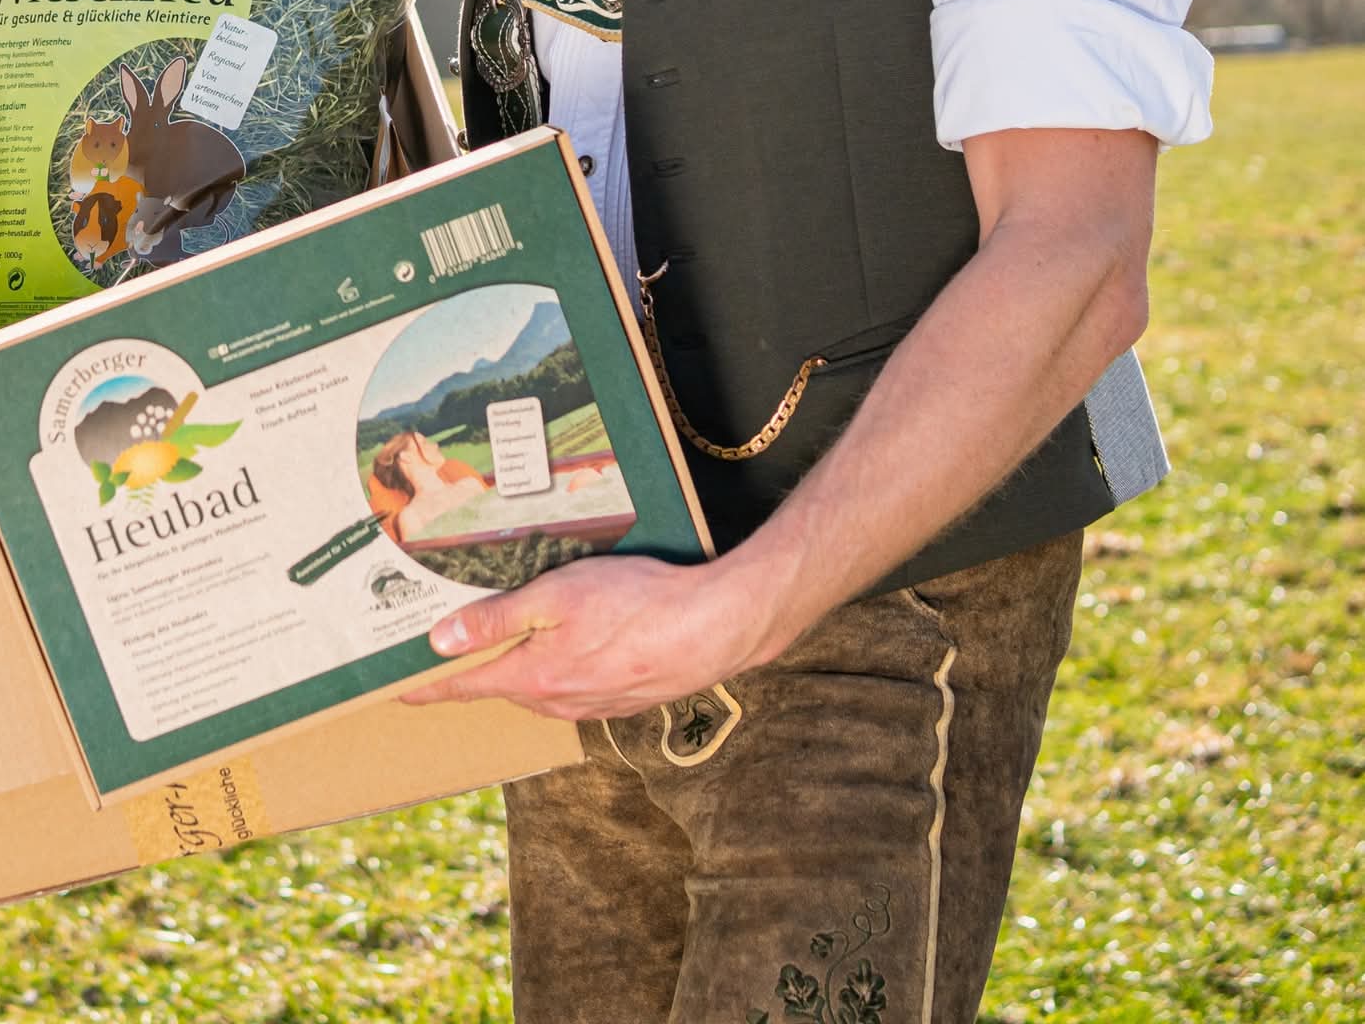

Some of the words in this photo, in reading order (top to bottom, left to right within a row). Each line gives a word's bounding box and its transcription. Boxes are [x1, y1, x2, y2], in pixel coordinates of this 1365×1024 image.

[12, 10, 58, 28] gesunde
[62, 10, 75, 22] &
[77, 9, 141, 27] glückliche
[146, 8, 211, 26] Kleintiere
[220, 20, 249, 36] Natur-
[32, 37, 72, 47] Wiesenheu
[215, 31, 249, 52] belassen
[208, 50, 246, 72] Regional
[201, 69, 218, 82] Von
[191, 93, 220, 111] Wiesen
[194, 83, 244, 108] artenreichen
[48, 352, 147, 444] Samerberger
[84, 466, 261, 563] Heubad
[220, 767, 253, 840] glückliche
